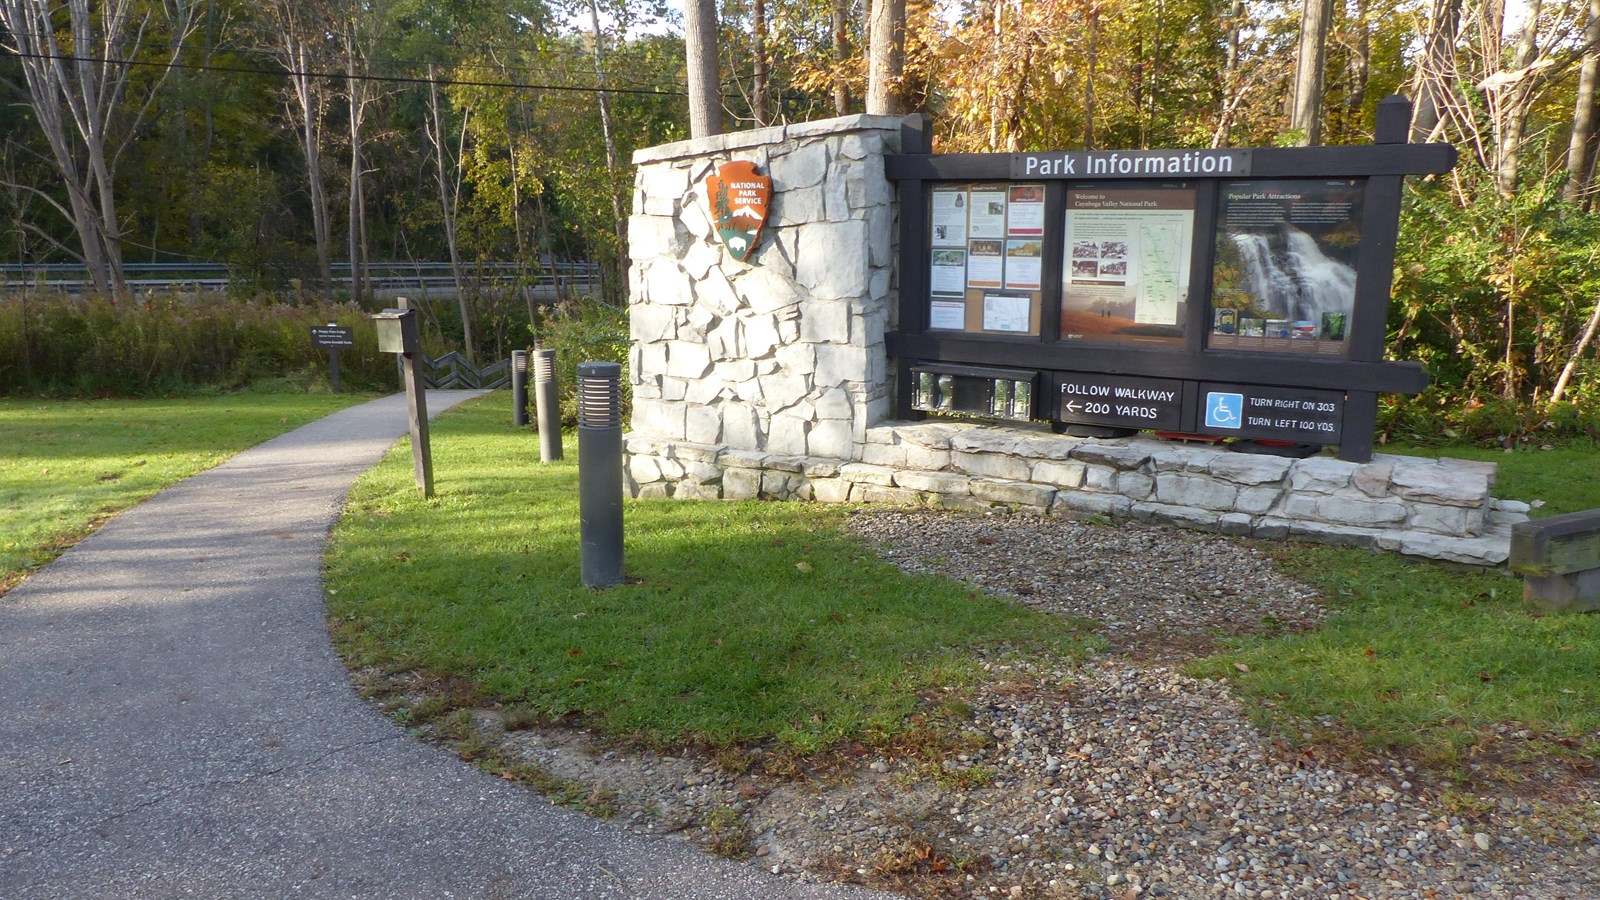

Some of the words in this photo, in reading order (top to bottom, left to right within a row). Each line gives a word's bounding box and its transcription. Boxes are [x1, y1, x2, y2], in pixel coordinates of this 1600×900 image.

[1025, 155, 1075, 175] Park
[1086, 151, 1233, 174] Information
[734, 197, 762, 205] SERVICE
[1061, 383, 1110, 396] FOLLOW
[1114, 387, 1175, 402] WALKWAY
[1084, 402, 1110, 414] 200
[1115, 405, 1157, 419] YARDS
[1250, 397, 1273, 407] TURN
[1274, 399, 1300, 409] RIGHT
[1302, 401, 1315, 411] ON
[1316, 402, 1335, 412] 303
[1248, 416, 1271, 427] TURN
[1275, 419, 1297, 428] LEFT
[1299, 420, 1315, 430] 100
[1317, 422, 1335, 432] YDS.
